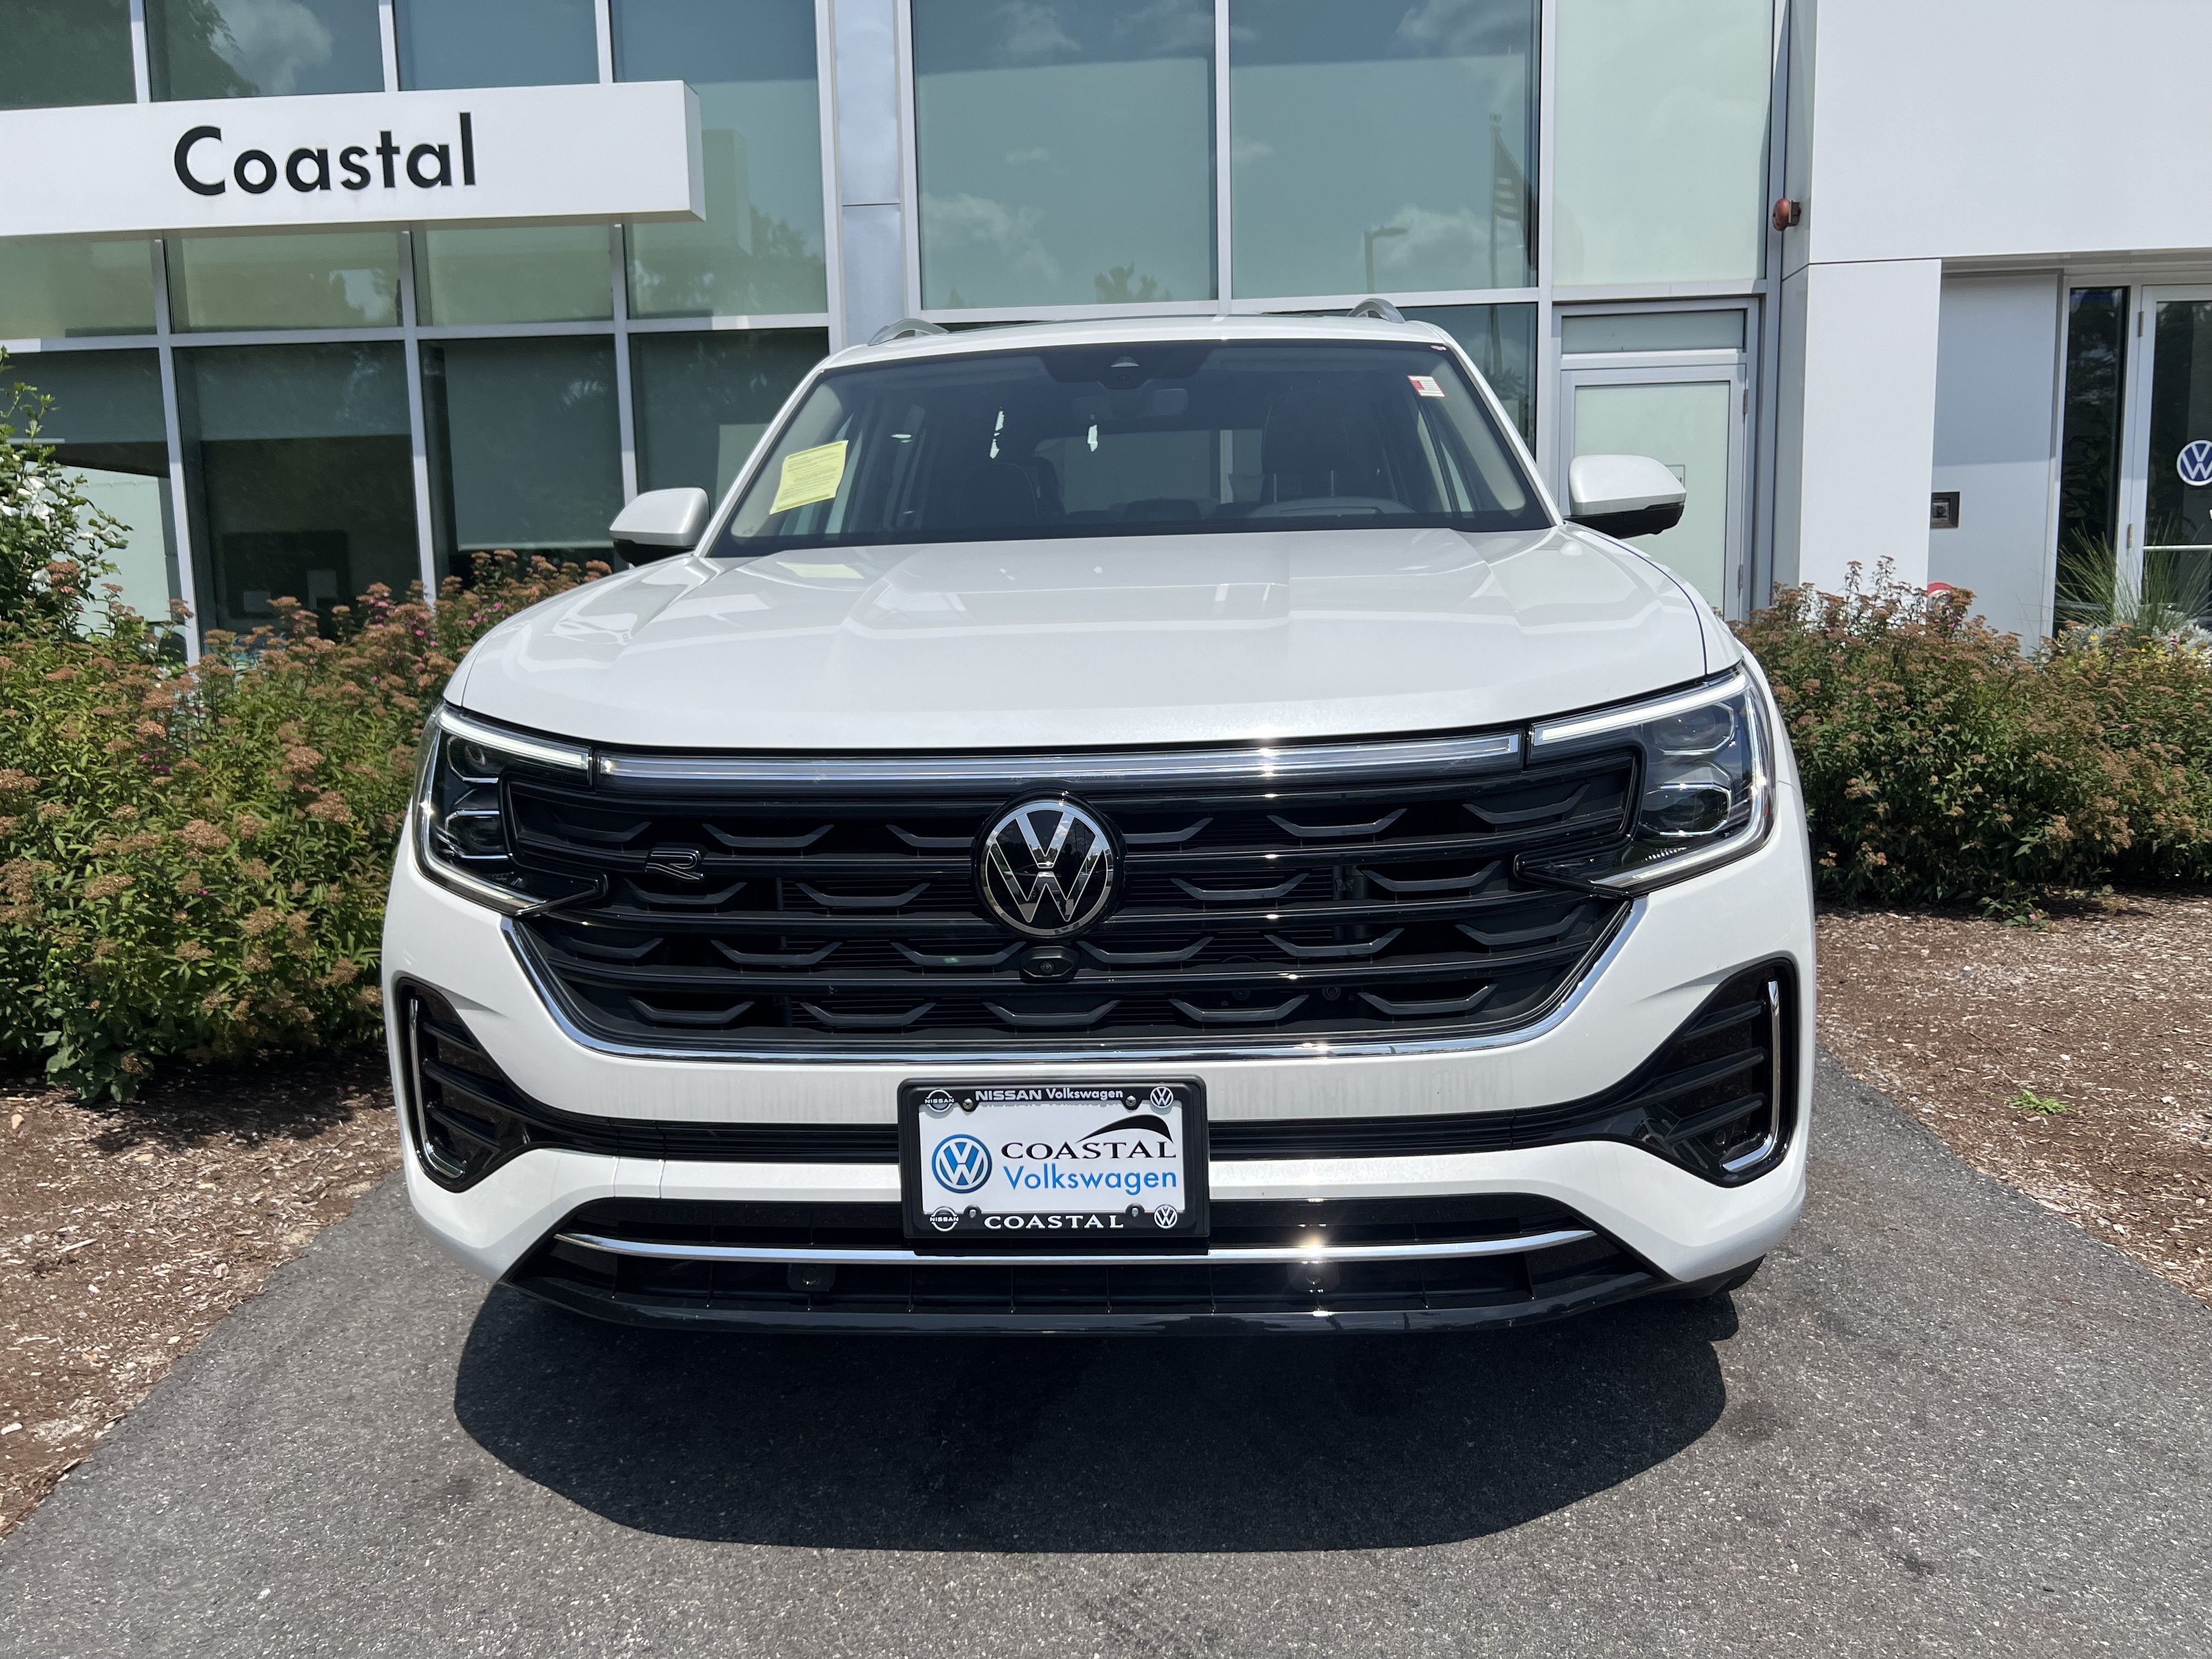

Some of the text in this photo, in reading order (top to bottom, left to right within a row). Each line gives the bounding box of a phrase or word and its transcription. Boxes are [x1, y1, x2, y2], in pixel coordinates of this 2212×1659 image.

[174, 111, 476, 196] Coastal
[2180, 441, 2212, 482] VW
[985, 805, 1109, 927] VW
[975, 1087, 1124, 1101] NISSAN Volkswagen
[1151, 1087, 1173, 1108] VW
[935, 1137, 989, 1190] VW
[1001, 1140, 1177, 1160] COASTAL
[1003, 1163, 1177, 1195] Volkswagen
[984, 1214, 1124, 1229] COASTAL
[1155, 1205, 1177, 1228] VW
